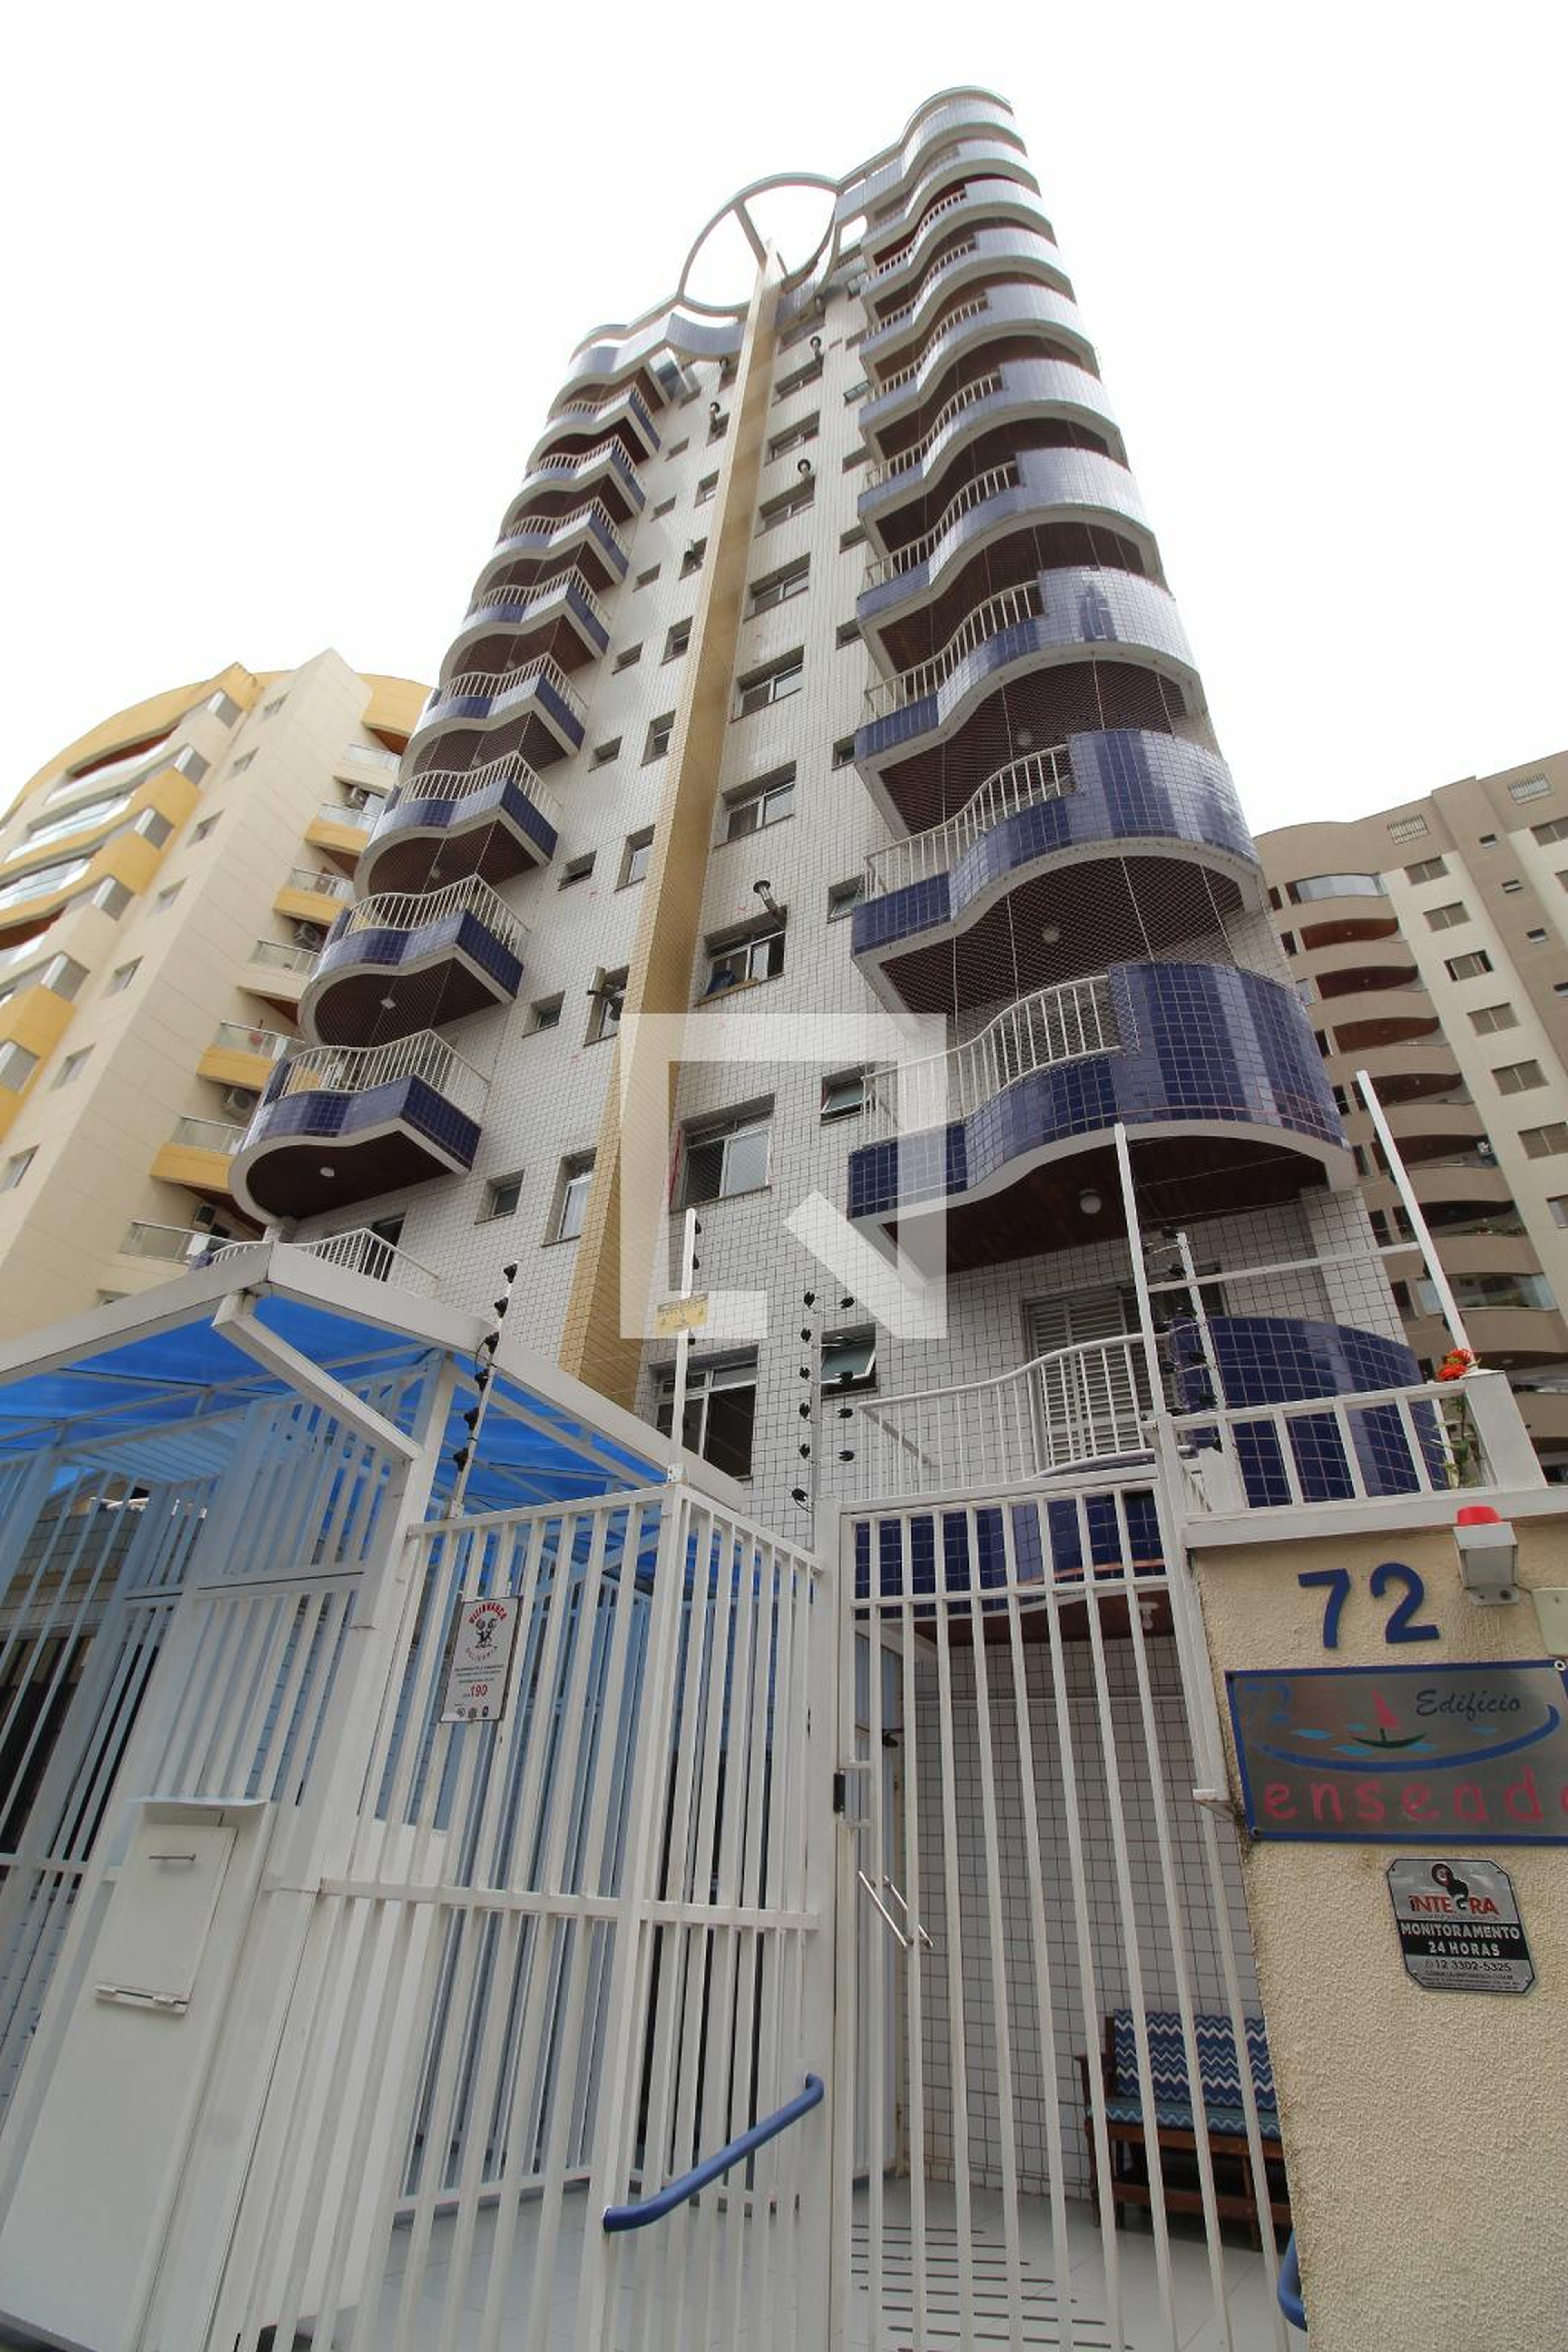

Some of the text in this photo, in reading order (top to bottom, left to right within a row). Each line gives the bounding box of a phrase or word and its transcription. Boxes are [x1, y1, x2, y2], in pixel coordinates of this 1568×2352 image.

[1298, 1563, 1440, 1648] 72
[471, 1684, 488, 1697] 190
[1263, 1764, 1568, 1824] ensead
[1401, 1922, 1520, 1940] MONITORAMENTO
[1428, 1941, 1501, 1957] 24 HORAS
[1436, 1960, 1448, 1969] 12
